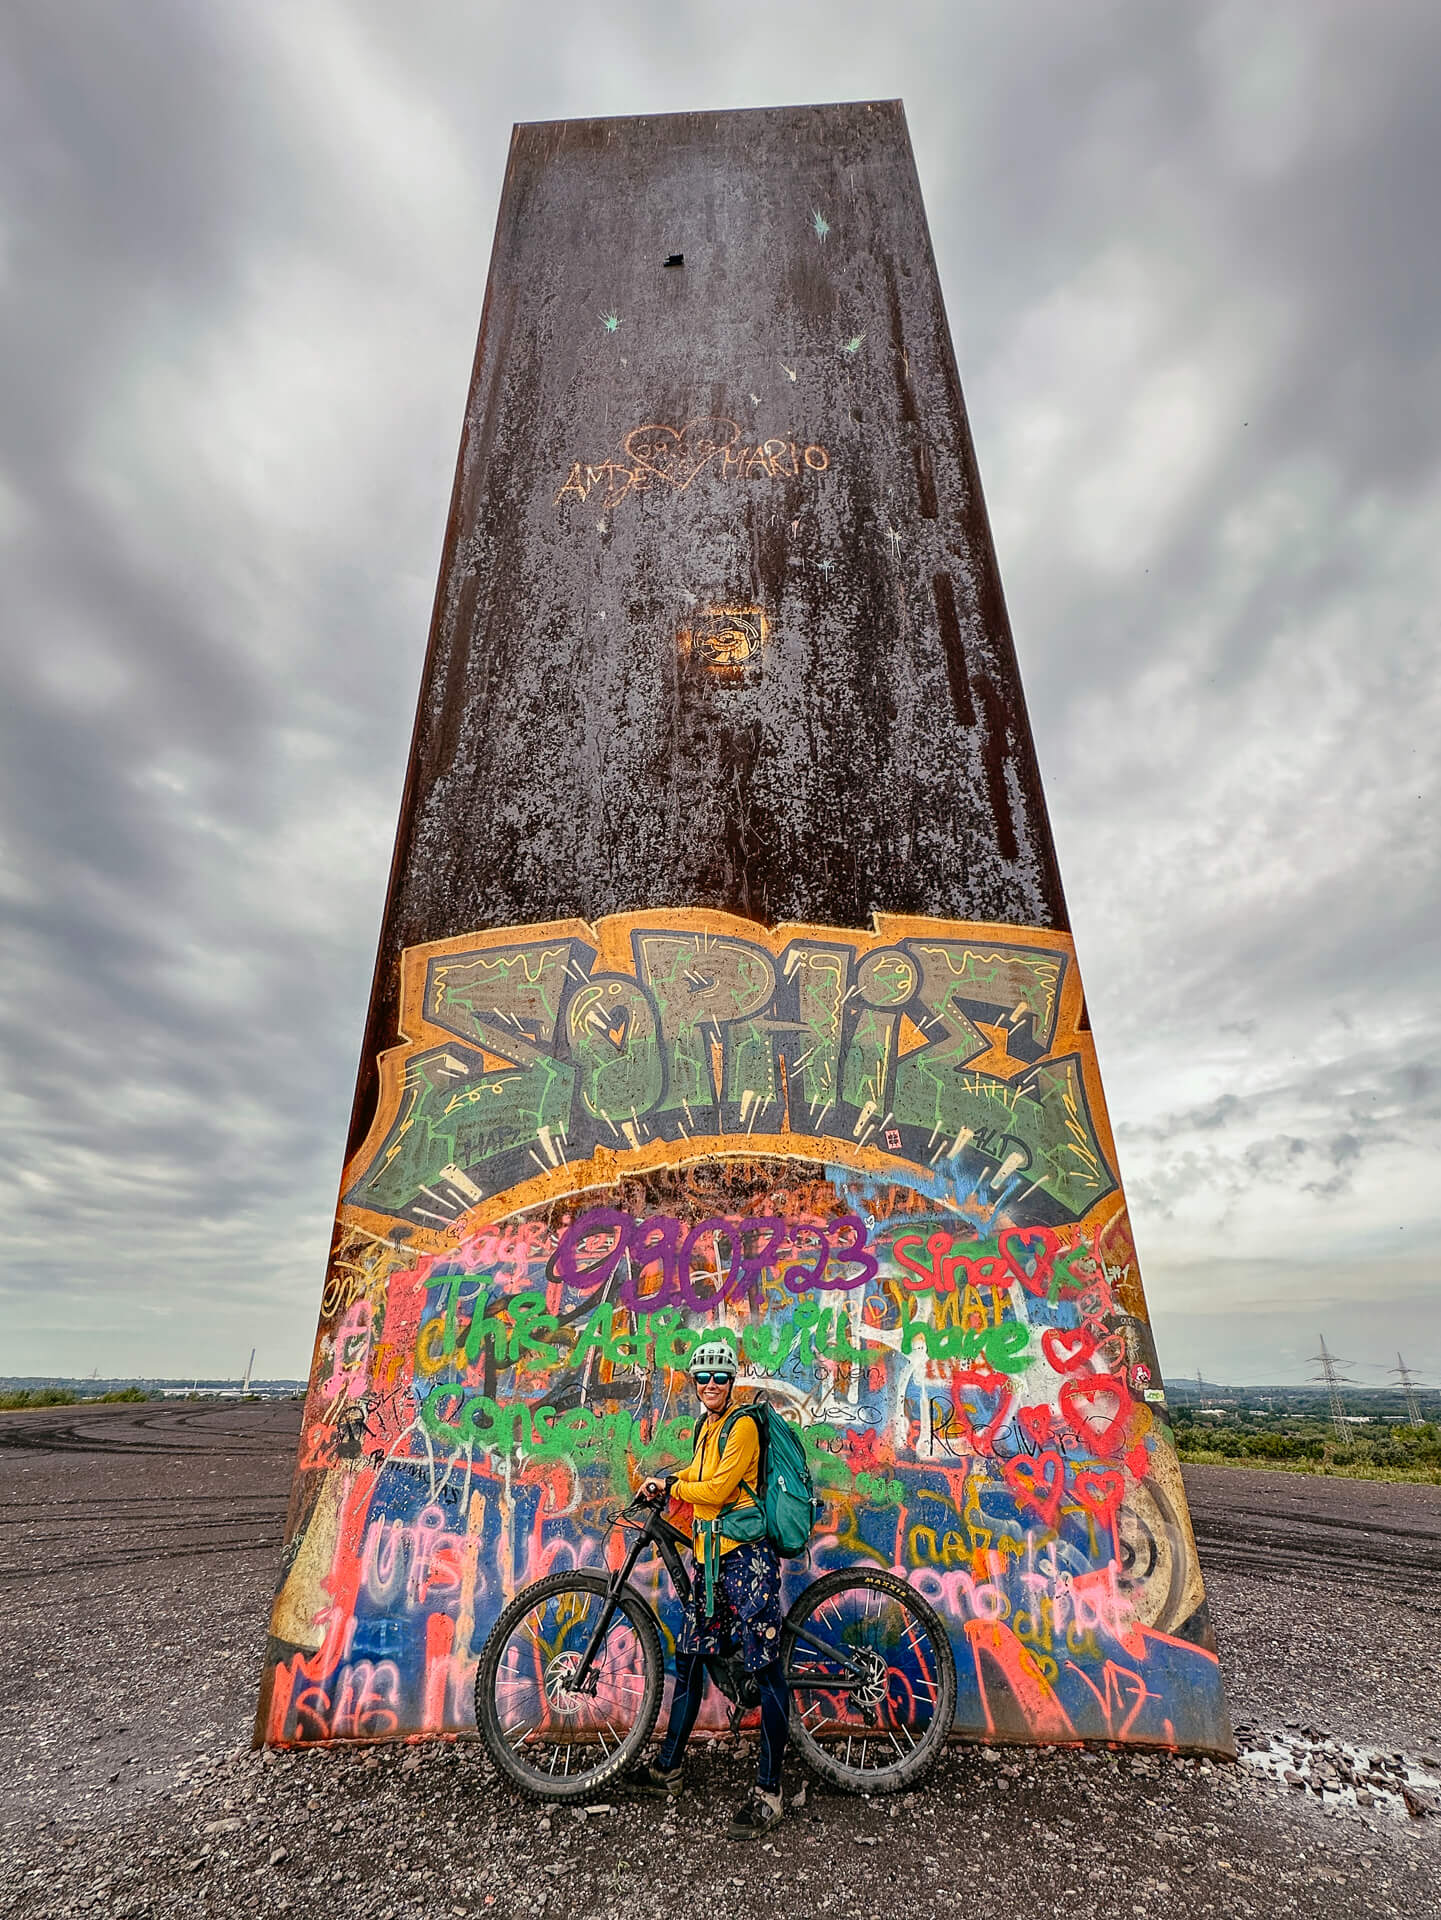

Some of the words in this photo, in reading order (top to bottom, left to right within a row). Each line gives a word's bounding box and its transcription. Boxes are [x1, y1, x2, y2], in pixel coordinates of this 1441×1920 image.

[722, 437, 830, 481] MARIO
[893, 1231, 1015, 1293] Sina
[424, 1274, 561, 1370] This
[742, 1302, 882, 1371] will
[901, 1299, 1036, 1374] have
[864, 1577, 907, 1597] MAXXIS
